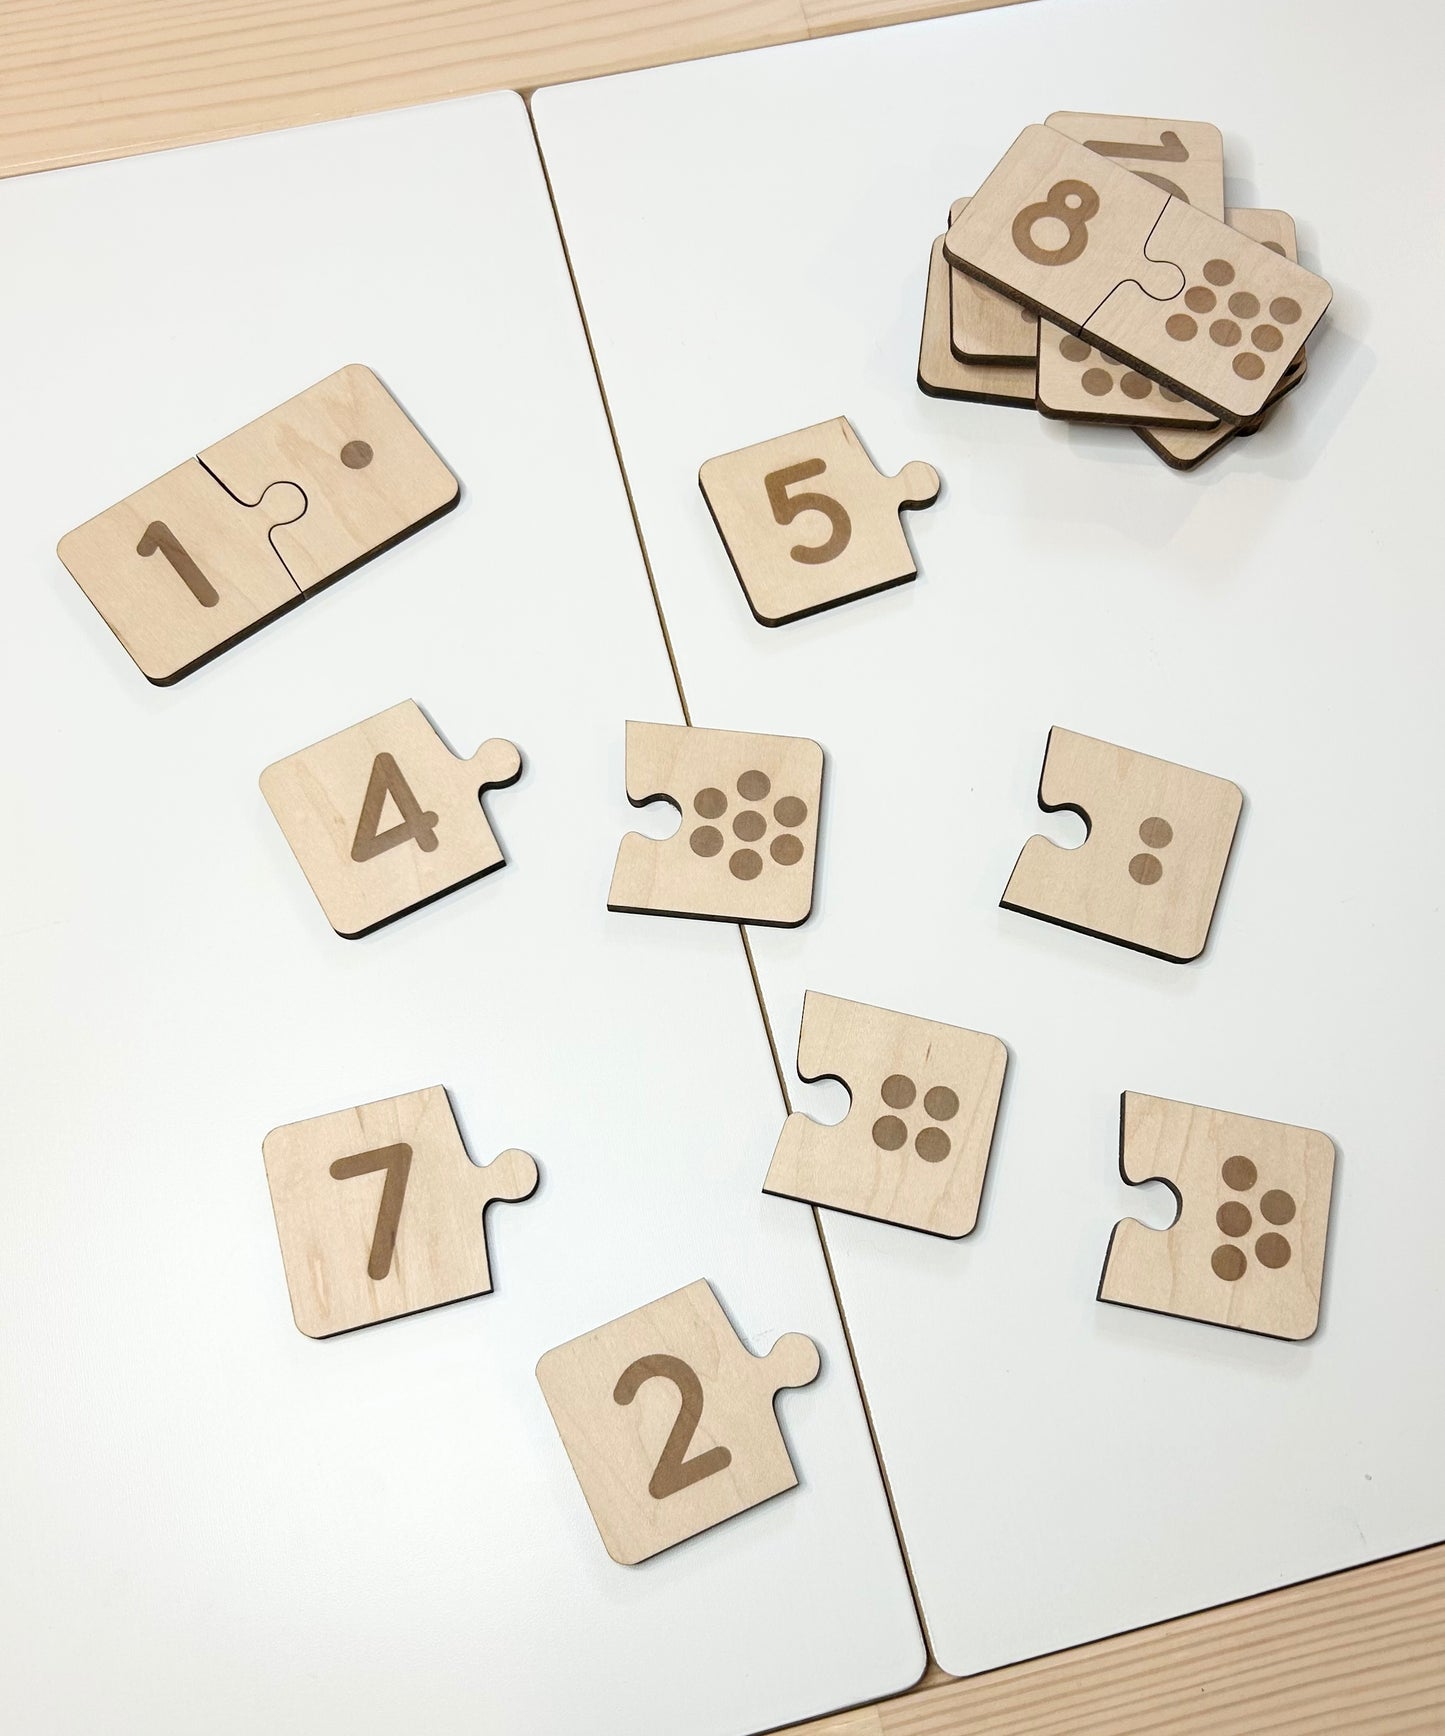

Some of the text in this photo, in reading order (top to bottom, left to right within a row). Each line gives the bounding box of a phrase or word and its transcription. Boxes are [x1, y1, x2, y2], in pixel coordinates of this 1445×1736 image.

[1011, 179, 1101, 266] 8
[136, 521, 219, 607] 1
[764, 458, 852, 565] 5
[351, 753, 439, 862] 4
[330, 1143, 413, 1281] 7
[613, 1354, 732, 1500] 2
